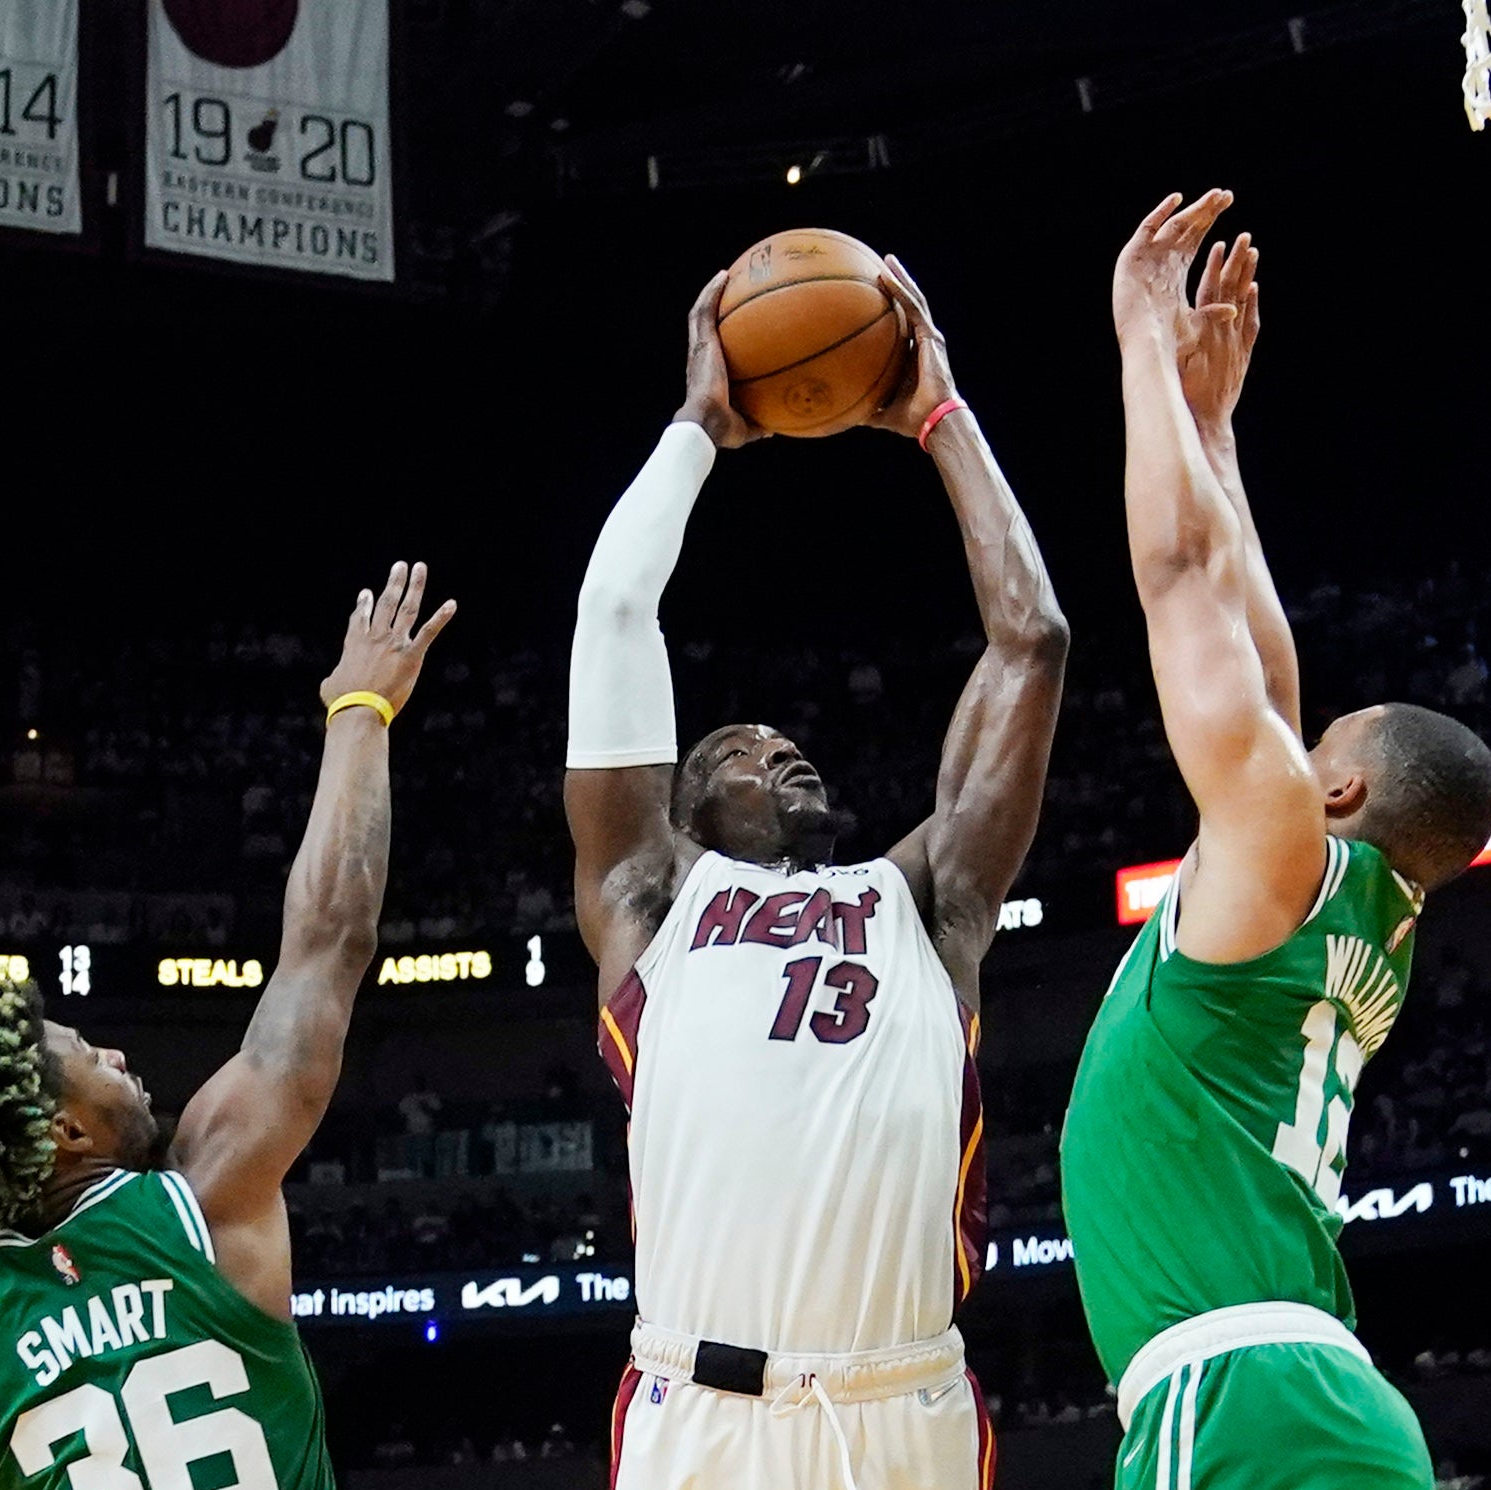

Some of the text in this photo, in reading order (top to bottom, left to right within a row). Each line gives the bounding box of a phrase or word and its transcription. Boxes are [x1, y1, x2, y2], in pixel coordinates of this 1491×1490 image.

[163, 91, 232, 167] 19
[300, 114, 376, 187] 20
[162, 200, 379, 264] CHAMPIONS
[688, 884, 882, 956] HEAT
[58, 944, 91, 971] 13
[157, 958, 263, 988] STEALS
[377, 950, 493, 986] ASSISTS
[767, 955, 880, 1045] 13
[330, 1285, 436, 1320] inspires
[576, 1272, 631, 1302] The
[16, 1277, 174, 1388] SMART
